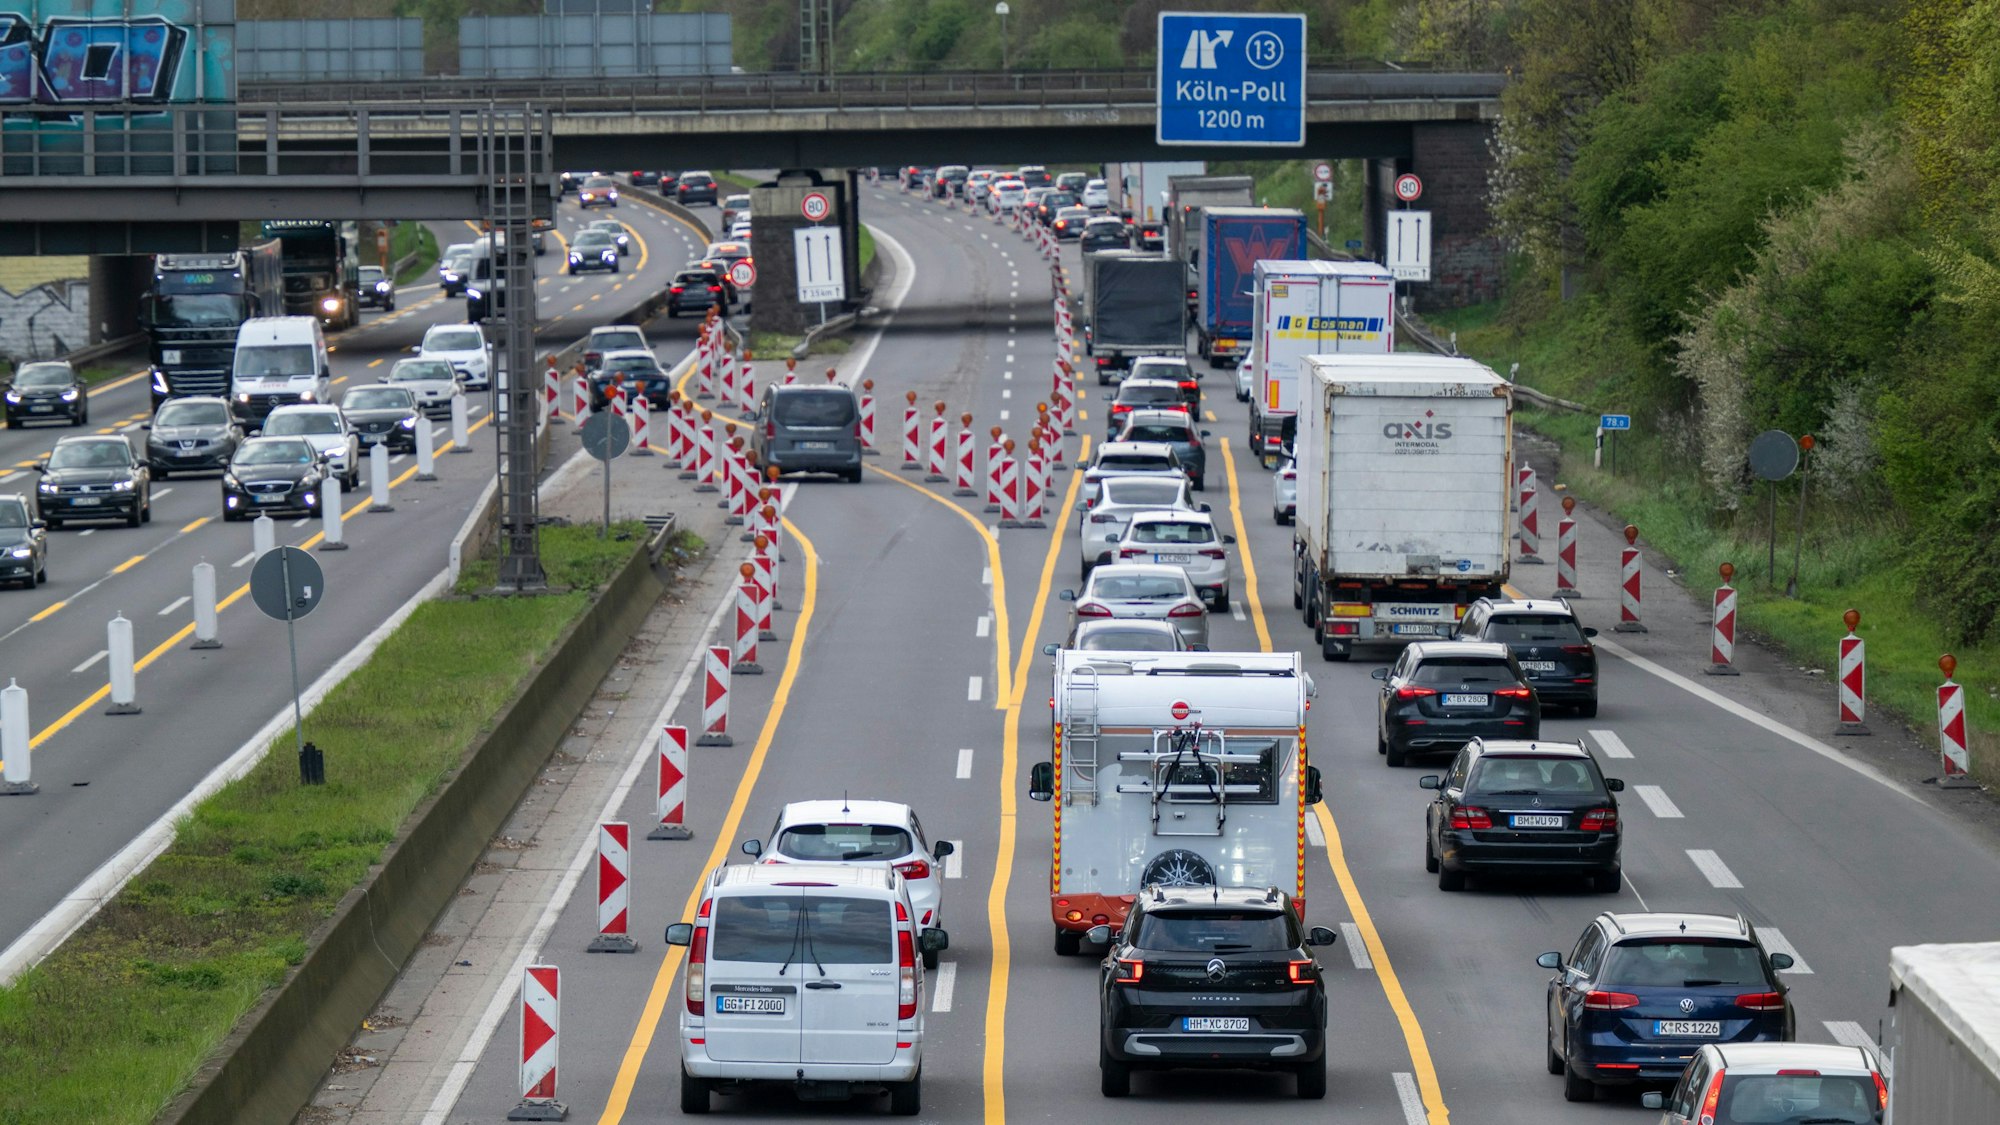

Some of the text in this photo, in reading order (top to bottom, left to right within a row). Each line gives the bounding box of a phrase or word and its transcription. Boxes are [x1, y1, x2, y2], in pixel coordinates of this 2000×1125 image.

[1253, 39, 1276, 60] 13
[1176, 80, 1286, 102] Köln-Poll
[1198, 109, 1265, 128] 1200 m
[1401, 181, 1416, 193] 80
[807, 200, 823, 213] 80
[1311, 318, 1364, 329] Bosman
[1383, 410, 1452, 440] axis
[1390, 607, 1439, 616] SCHMITZ
[1447, 694, 1487, 703] K BX 2805
[1517, 816, 1559, 826] BM WU 99
[1174, 852, 1183, 861] N
[724, 998, 782, 1011] GG FI 2000
[1189, 1018, 1248, 1030] HH XC 8702
[1660, 1022, 1719, 1034] K RS 1226
